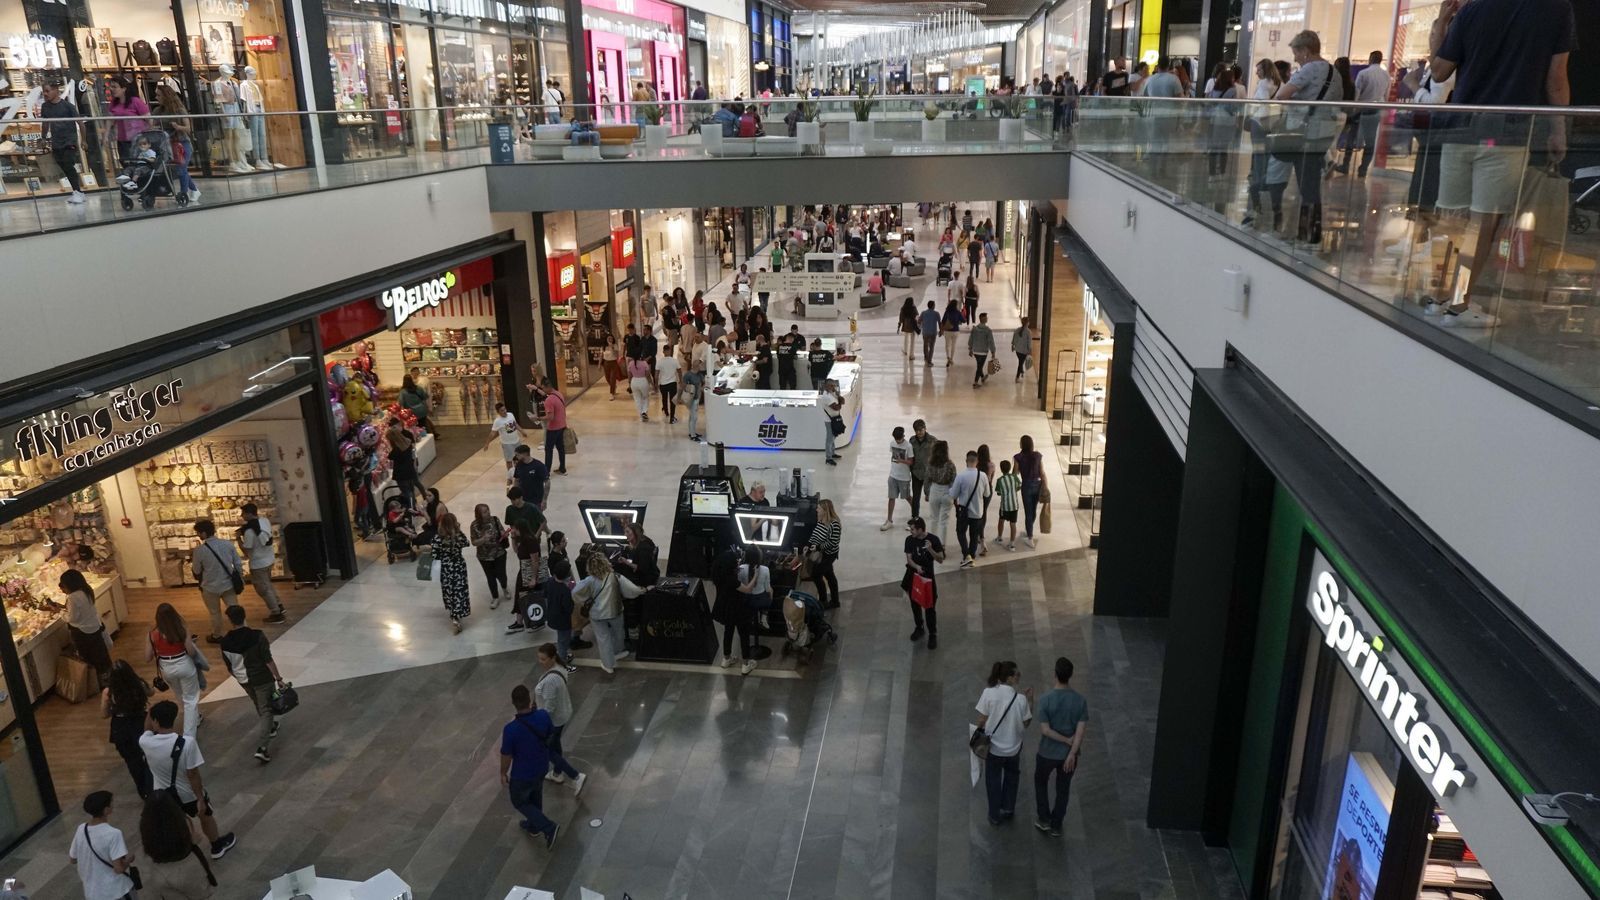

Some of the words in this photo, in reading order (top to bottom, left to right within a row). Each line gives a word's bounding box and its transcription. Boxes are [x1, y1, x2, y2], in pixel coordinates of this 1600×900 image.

[496, 53, 528, 61] ADDAS
[14, 407, 113, 462] flying
[113, 378, 183, 423] tiger
[758, 424, 788, 438] SHS
[64, 421, 162, 472] copenhagen
[1312, 571, 1466, 797] Sprinter
[1348, 783, 1361, 804] SE
[1345, 799, 1384, 862] DEPORTE
